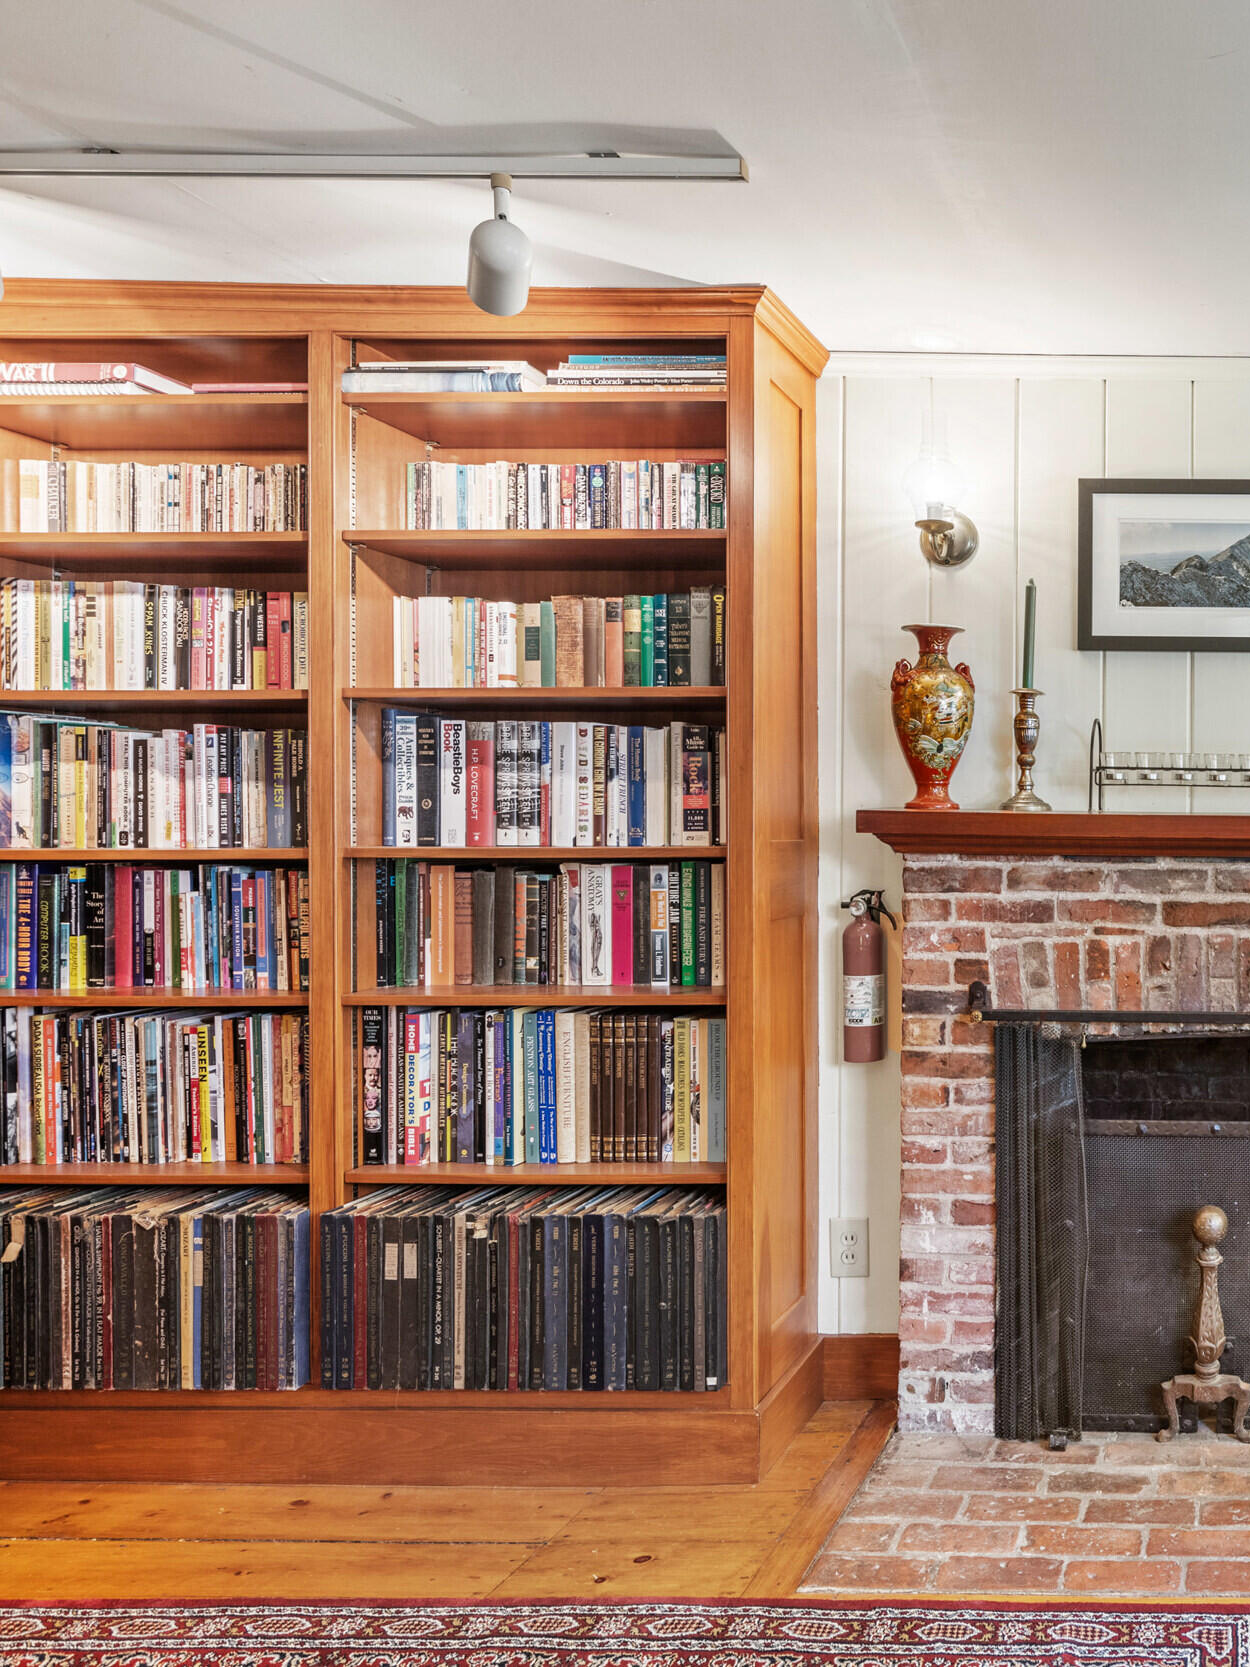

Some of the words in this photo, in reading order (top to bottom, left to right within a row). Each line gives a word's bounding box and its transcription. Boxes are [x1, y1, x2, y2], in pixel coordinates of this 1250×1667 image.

[557, 377, 579, 385] Down
[581, 377, 592, 385] the
[592, 377, 625, 385] Colorado
[711, 477, 724, 503] OXFORD
[235, 590, 244, 610] HTML
[298, 600, 306, 653] MACROBIOTIC
[714, 614, 724, 644] MARRIAGE
[298, 656, 306, 676] DIET
[161, 677, 168, 685] IV
[443, 723, 452, 753] Book
[593, 727, 605, 740] KIM
[273, 731, 284, 780] INFINITE
[396, 737, 405, 793] Collectibles
[404, 737, 414, 781] Antiques
[451, 723, 463, 795] BeastieBoys
[471, 748, 479, 763] H.P.
[593, 740, 605, 767] GORDON
[207, 755, 216, 783] Leading
[593, 769, 605, 783] GIRL
[688, 757, 703, 793] Rock
[273, 782, 284, 808] JEST
[404, 782, 414, 791] &
[471, 766, 479, 820] LOVECRAFT
[502, 757, 511, 813] SPRINGSTEEN
[522, 757, 531, 813] SPRINGSTEEN
[593, 784, 605, 792] IN
[593, 798, 605, 816] BAND
[587, 869, 595, 912] ANATOMY
[595, 875, 603, 905] GRAY'S
[669, 872, 679, 904] CULTURE
[682, 868, 692, 887] EATING
[18, 899, 31, 914] THE
[87, 901, 103, 909] Story
[682, 888, 692, 908] ANIMALS
[40, 900, 49, 940] COMPUTER
[300, 902, 309, 935] HELPFUL
[669, 907, 679, 923] JAM
[18, 951, 31, 973] BODY
[40, 943, 49, 973] BOOK
[33, 1020, 42, 1042] DADA
[408, 1024, 416, 1051] HOME
[677, 1031, 685, 1042] OLD
[198, 1031, 207, 1083] UNSEEN
[450, 1036, 458, 1055] THE
[527, 1036, 535, 1068] FENTON
[563, 1031, 571, 1073] ENGLISH
[33, 1049, 42, 1096] SURREALISM
[450, 1057, 458, 1086] BLACK
[527, 1069, 535, 1086] ART
[677, 1060, 685, 1089] MAGAZINES
[408, 1054, 416, 1125] DECORATOR'S
[527, 1087, 535, 1112] GLASS
[563, 1075, 571, 1128] FURNITURE
[714, 1091, 721, 1101] UP
[33, 1097, 42, 1119] Robert
[450, 1091, 458, 1116] BOOK
[677, 1091, 685, 1124] NEWSPAPERS
[408, 1127, 416, 1155] BIBLE
[435, 1285, 443, 1293] IN
[96, 1306, 102, 1314] IN
